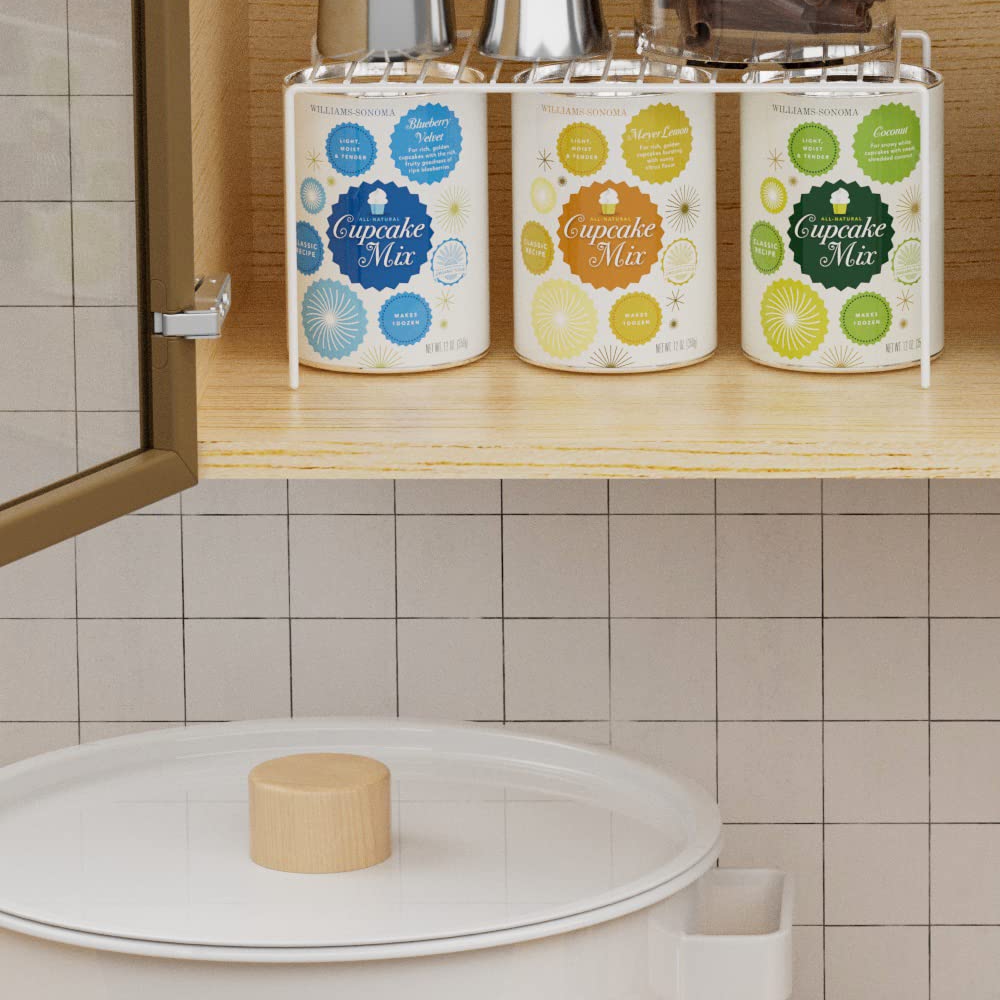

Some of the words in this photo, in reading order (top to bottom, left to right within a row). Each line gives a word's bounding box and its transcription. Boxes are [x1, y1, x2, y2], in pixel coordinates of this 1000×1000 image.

[310, 104, 396, 117] WILLIAMS-SONOMA
[542, 104, 627, 117] WILLIAMS-SONOMA
[772, 104, 859, 117] WILLIAMS-SONOMA
[405, 117, 450, 130] Blueberry
[415, 131, 444, 144] Velvet
[661, 126, 688, 138] Lemon
[873, 126, 909, 137] Coconut
[333, 214, 425, 246] Cupcake
[563, 214, 656, 245] Cupcake
[794, 214, 887, 245] Cupcake
[297, 240, 318, 250] LASSIC
[753, 239, 778, 250] CLASSIC
[357, 241, 416, 268] Mix
[588, 241, 646, 268] Mix
[820, 241, 877, 268] Mix
